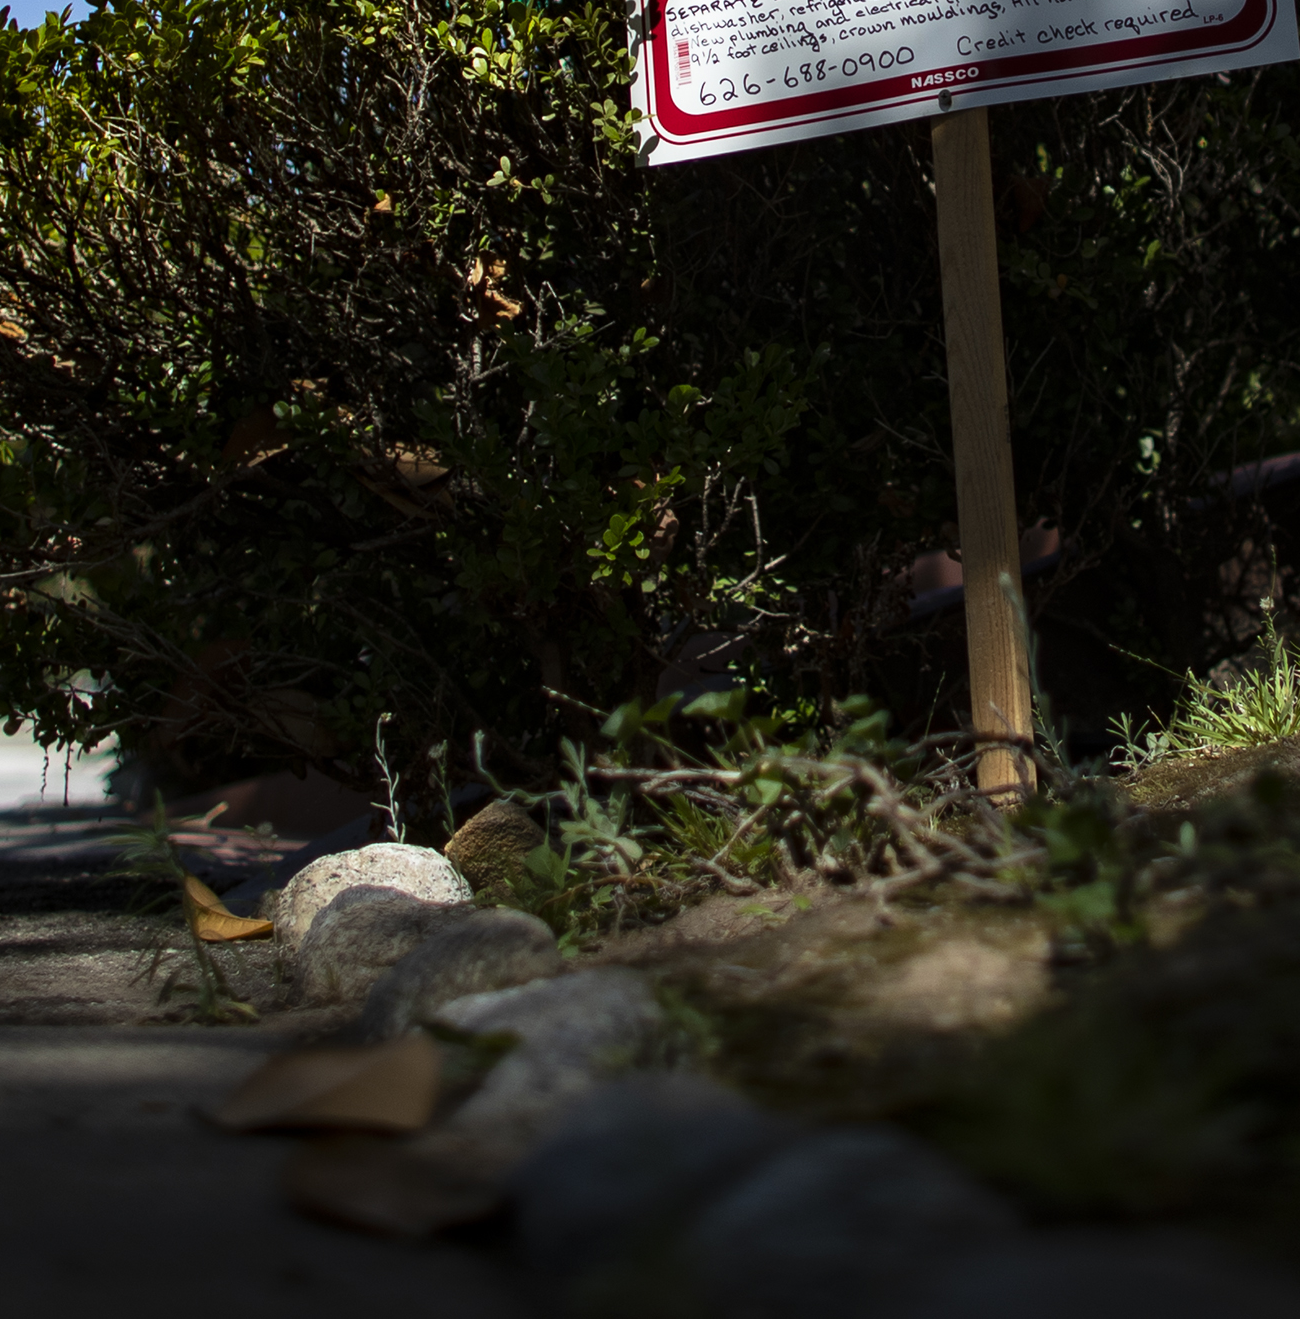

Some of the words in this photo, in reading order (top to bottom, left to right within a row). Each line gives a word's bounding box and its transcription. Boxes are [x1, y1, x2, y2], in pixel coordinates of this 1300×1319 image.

[671, 8, 785, 38] dishwasher,
[691, 35, 725, 49] New
[730, 21, 814, 47] plumbing
[816, 10, 851, 28] and
[957, 29, 1026, 56] Credit
[1037, 18, 1098, 44] check
[1104, 0, 1199, 35] required
[1203, 14, 1224, 24] LP-6
[727, 44, 757, 59] foot
[839, 20, 896, 40] crown
[700, 46, 915, 105] 626-688-0900
[911, 67, 979, 89] NASSCO
